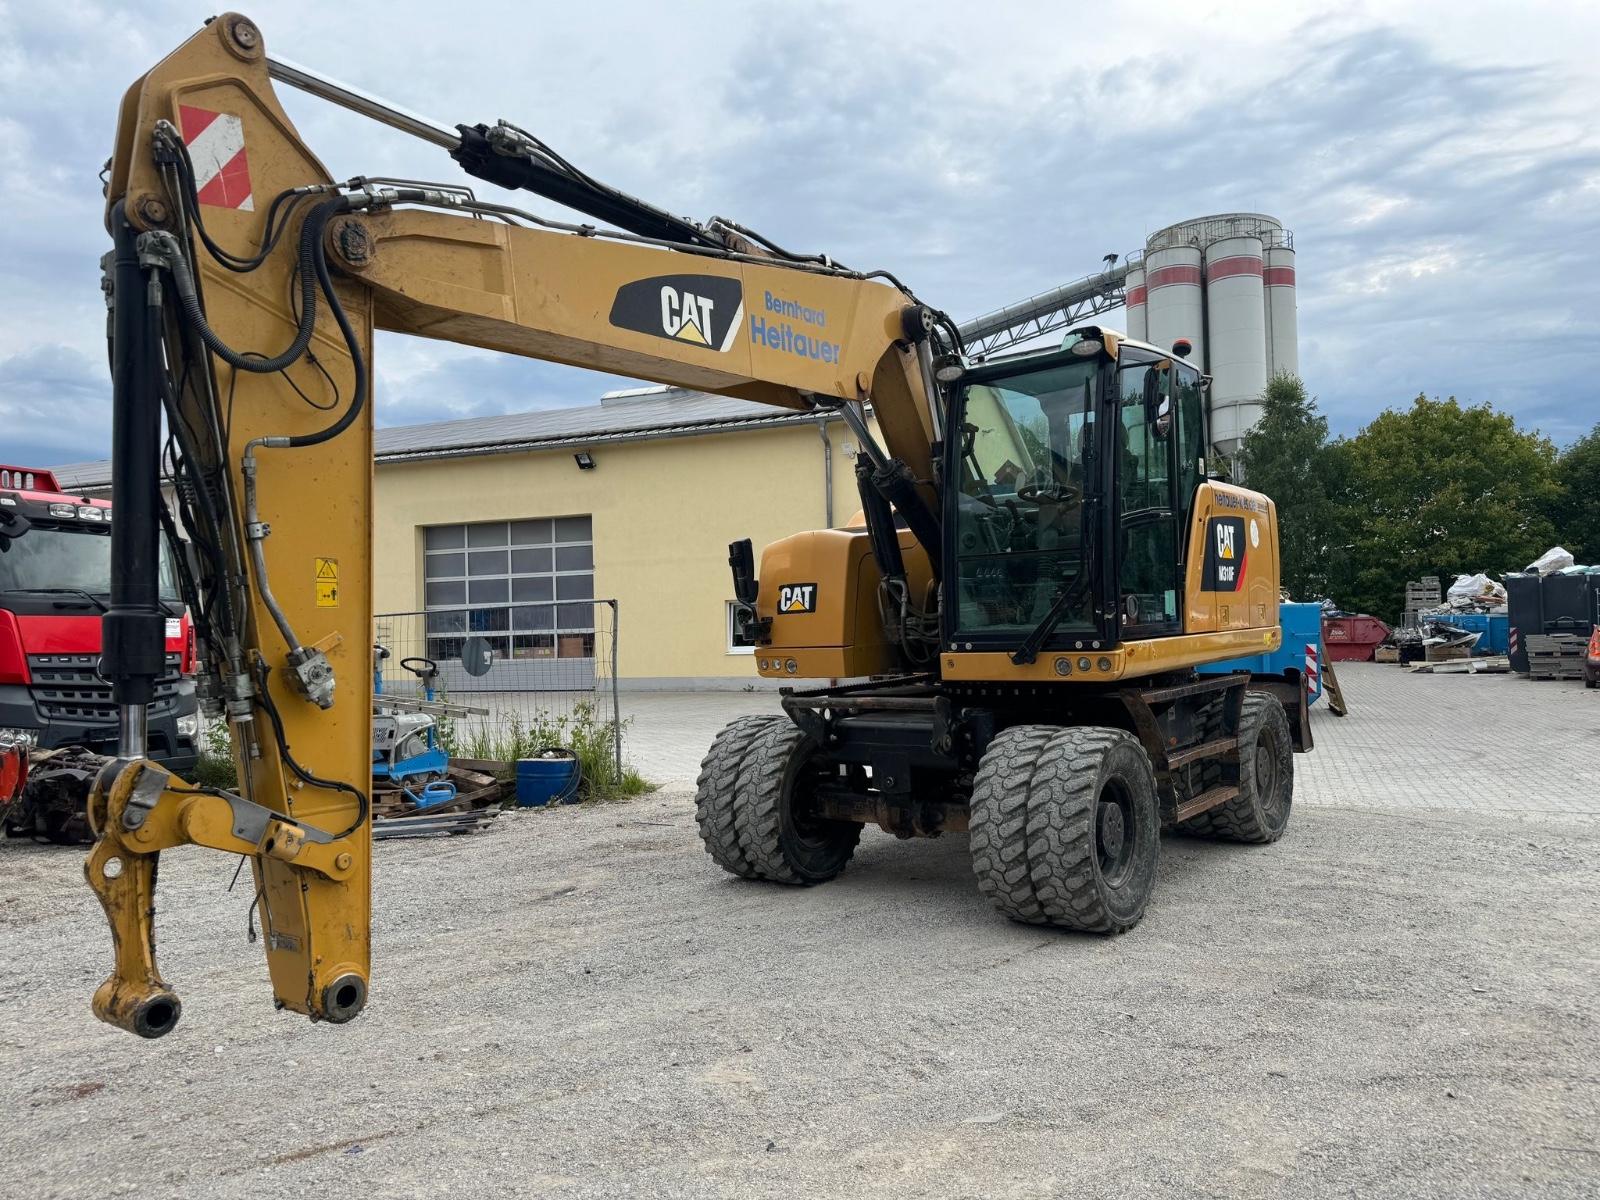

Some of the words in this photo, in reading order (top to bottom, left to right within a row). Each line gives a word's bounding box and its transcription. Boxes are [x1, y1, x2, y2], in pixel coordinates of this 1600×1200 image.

[661, 286, 713, 345] CAT
[765, 290, 825, 327] Bernhard
[751, 313, 839, 364] Heitauer
[1217, 523, 1234, 559] CAT
[781, 586, 813, 611] CAT
